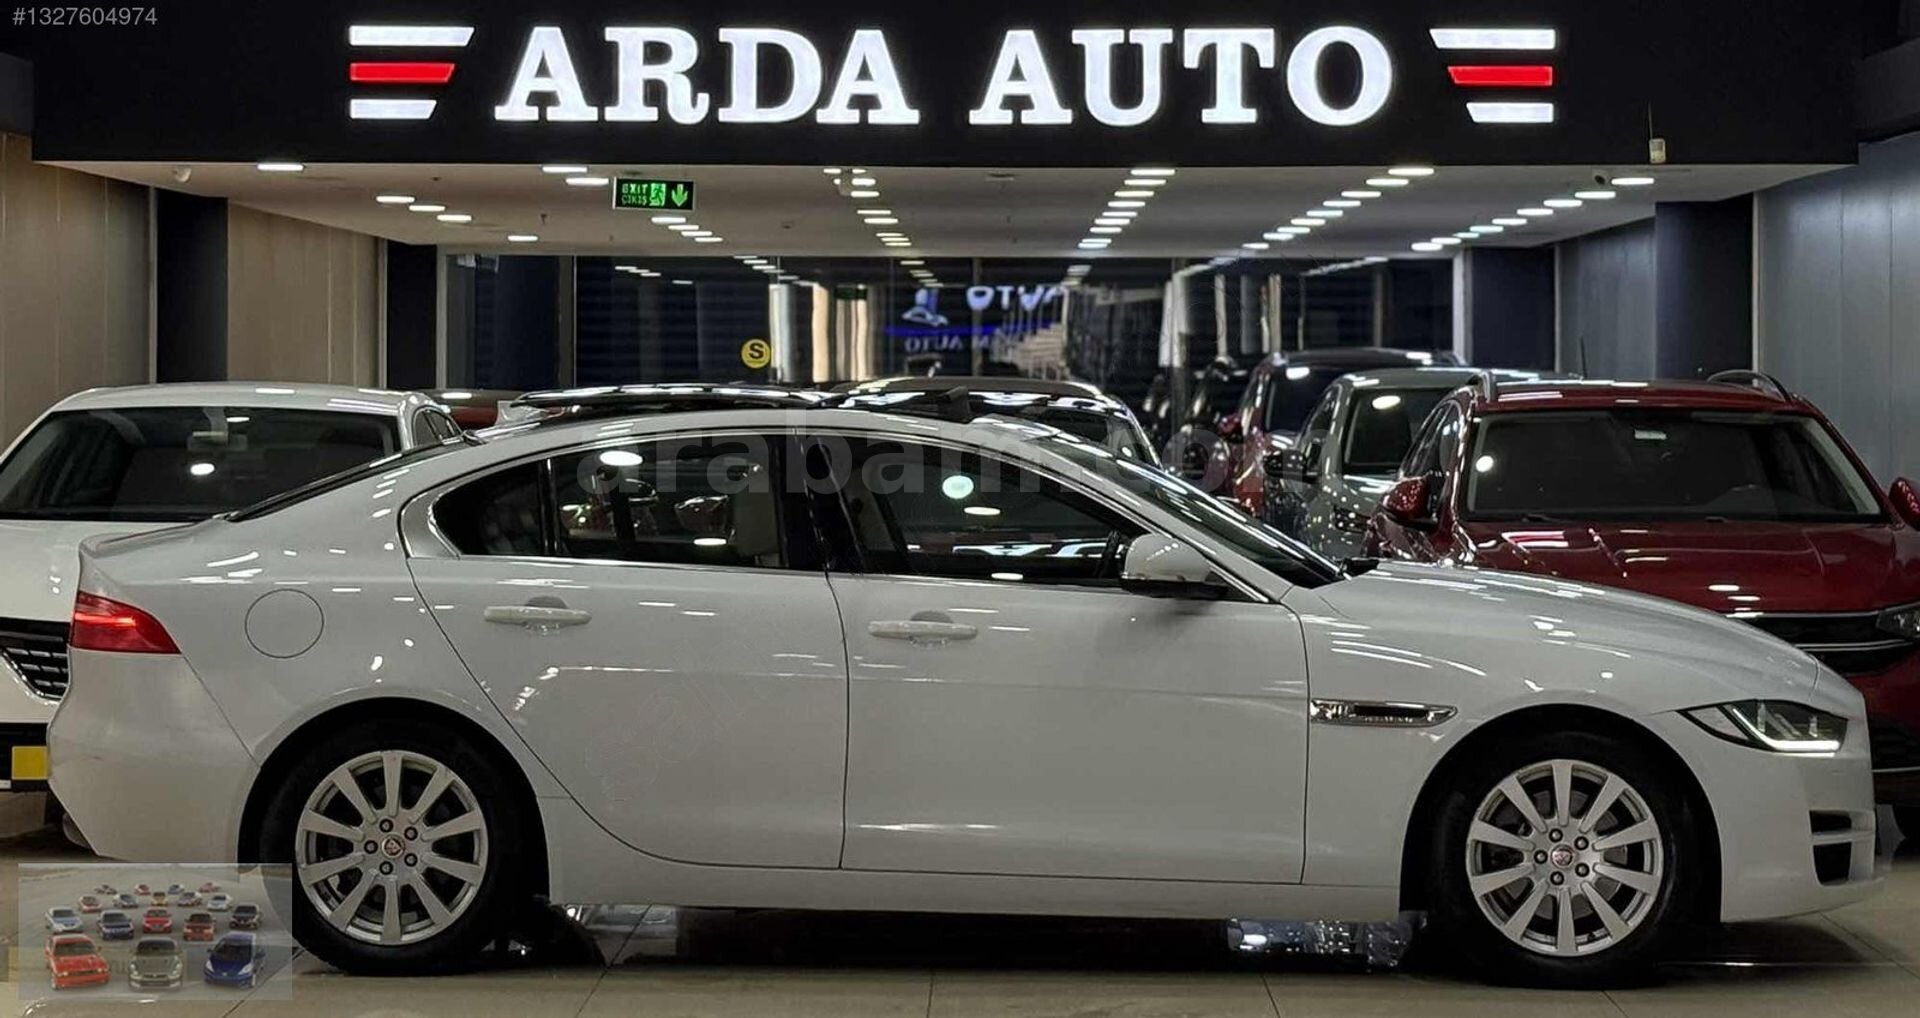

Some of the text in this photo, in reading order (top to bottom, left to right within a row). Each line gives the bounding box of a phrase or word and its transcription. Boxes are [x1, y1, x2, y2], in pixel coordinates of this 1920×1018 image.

[494, 25, 1393, 126] ARDA AUTO
[622, 183, 648, 194] EXIT
[749, 342, 764, 360] S
